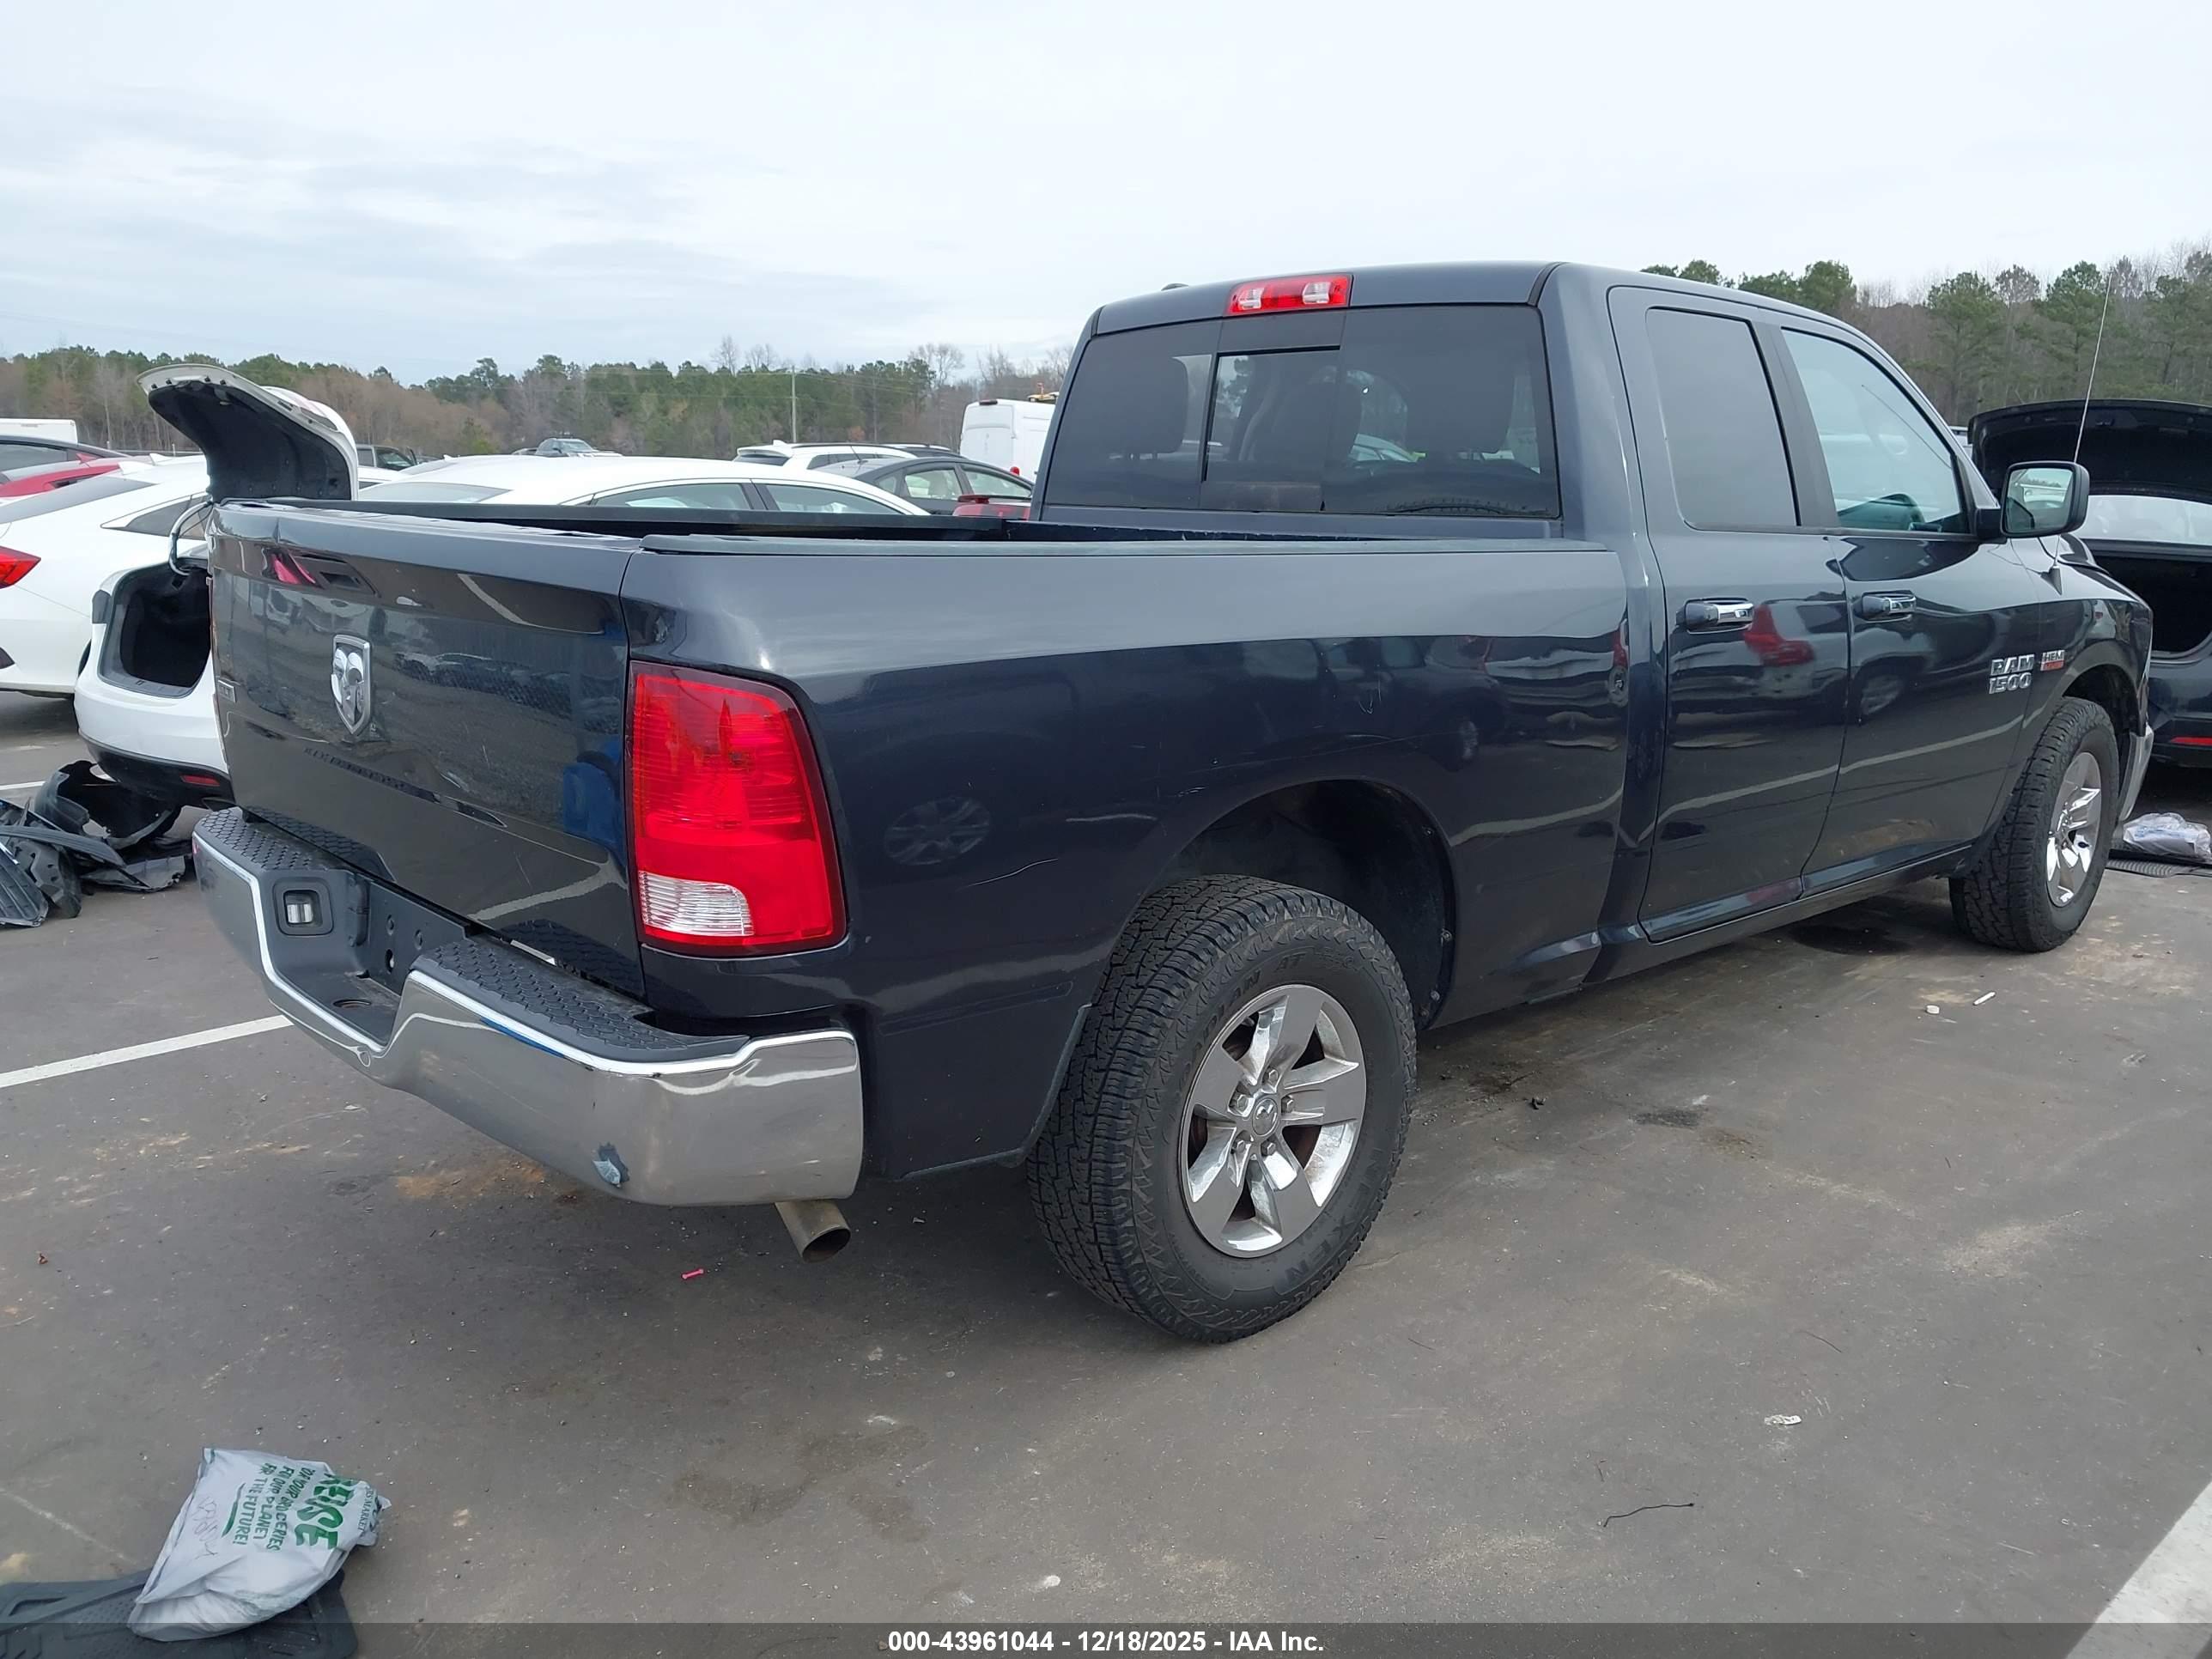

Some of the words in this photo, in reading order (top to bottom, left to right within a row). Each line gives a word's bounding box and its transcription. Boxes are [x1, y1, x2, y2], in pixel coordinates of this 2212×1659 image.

[1990, 654, 2034, 676] RAM
[1989, 672, 2032, 694] 1500
[248, 1478, 268, 1493] THE
[233, 1496, 258, 1545] FUTURE!
[253, 1497, 276, 1539] PLANET
[266, 1497, 294, 1551] GROCERIES
[357, 1498, 374, 1532] MARKET
